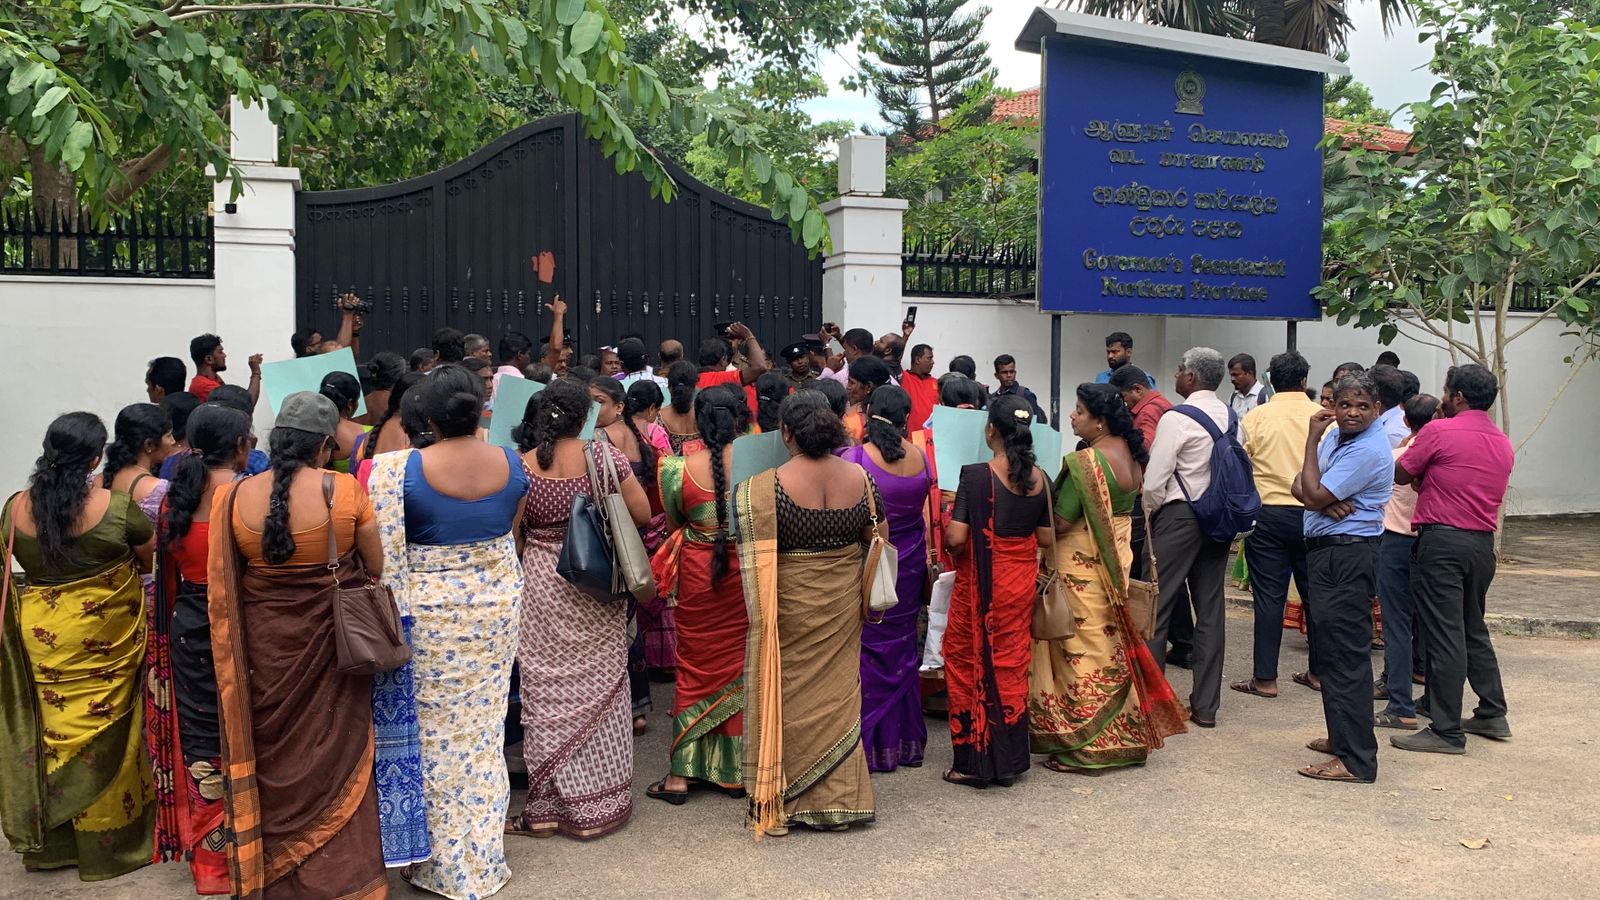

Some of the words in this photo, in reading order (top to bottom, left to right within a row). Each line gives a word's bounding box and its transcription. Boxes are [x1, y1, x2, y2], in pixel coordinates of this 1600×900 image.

[1187, 122, 1290, 149] செயலகம்
[1109, 148, 1145, 165] வட
[1159, 152, 1265, 173] மாகாணம்
[1128, 213, 1186, 239] උතුරු
[1191, 218, 1243, 239] පළාත
[1083, 248, 1185, 273] Governor's
[1190, 253, 1287, 277] Secretariat
[1101, 275, 1186, 299] Northern
[1190, 278, 1268, 301] Province
